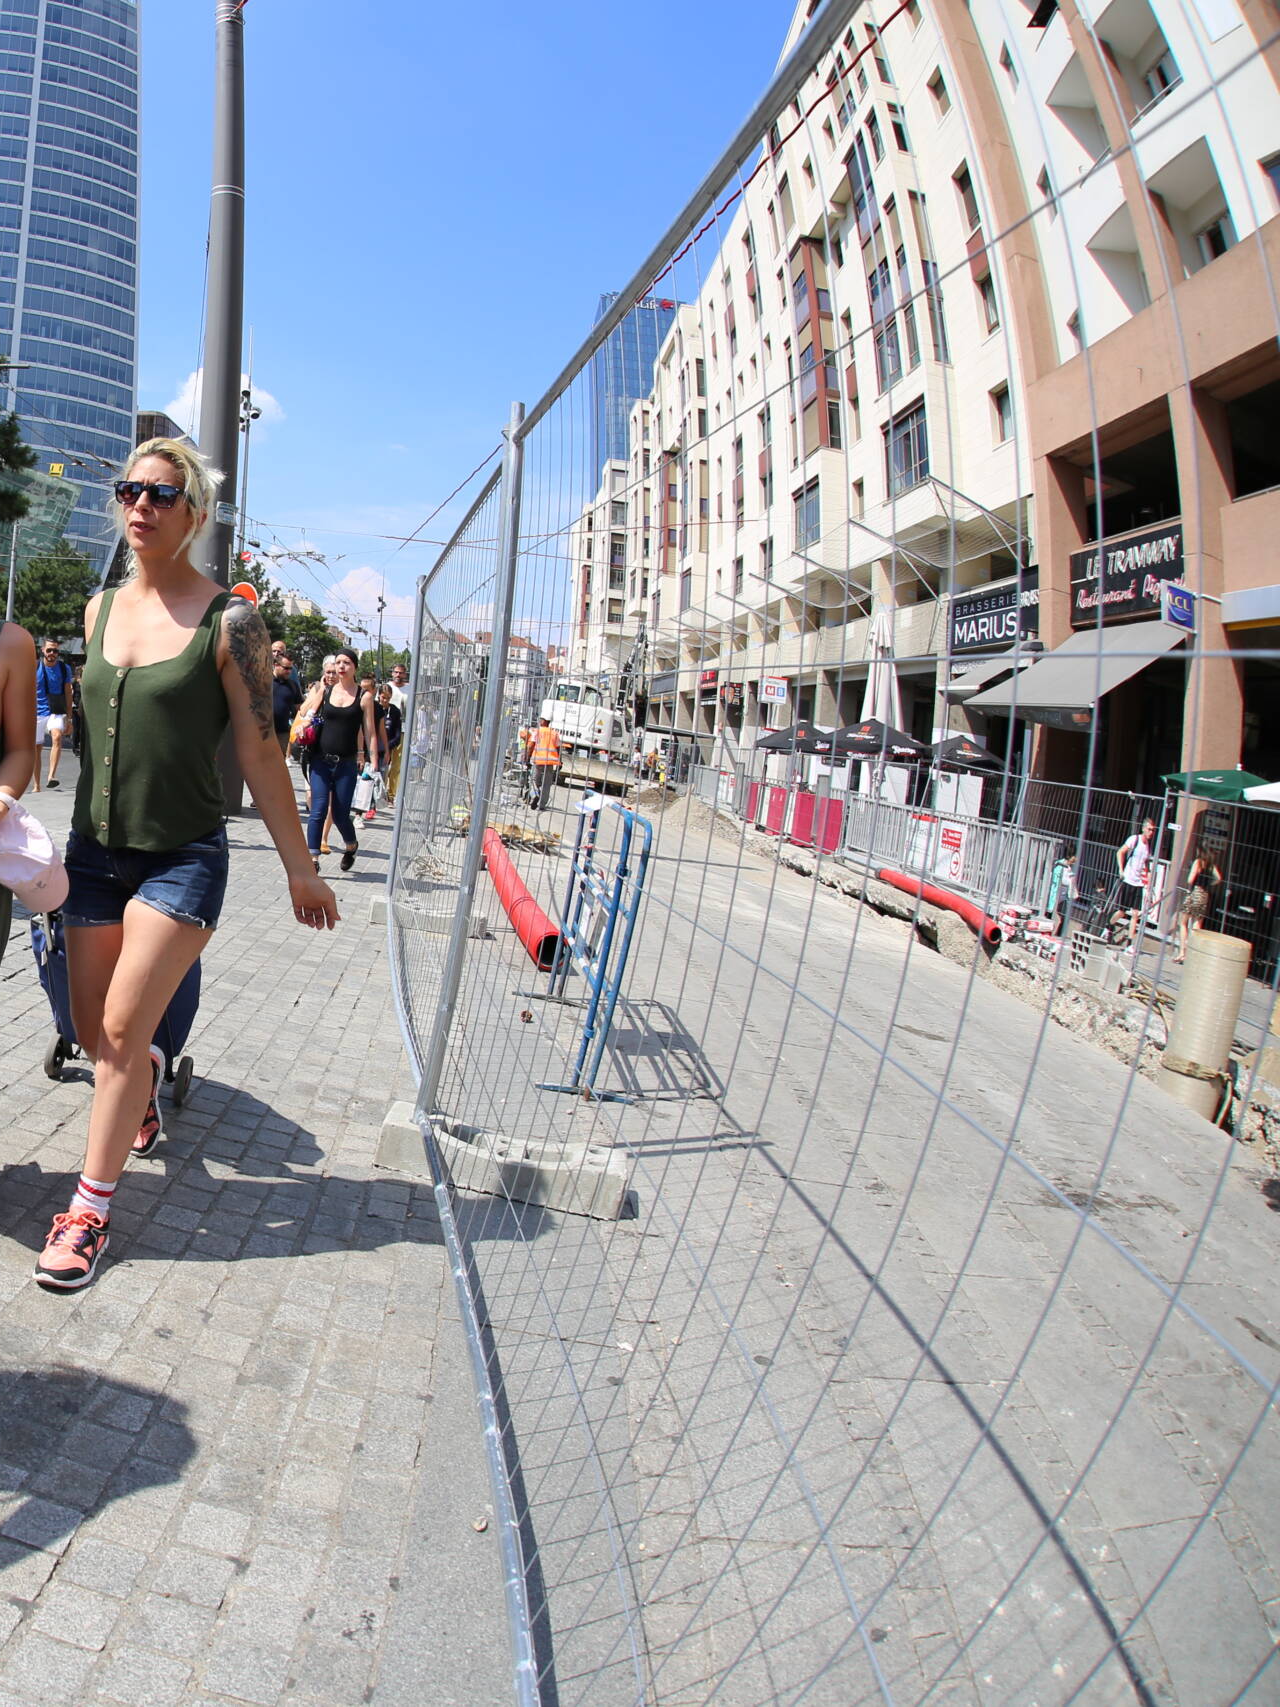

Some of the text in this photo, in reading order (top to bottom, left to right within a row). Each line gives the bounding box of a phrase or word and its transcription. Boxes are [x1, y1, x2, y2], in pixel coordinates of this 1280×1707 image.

[1086, 534, 1180, 580] LE TRAMWAY
[955, 593, 1018, 617] BRASSERIE
[1166, 591, 1190, 612] LCL
[954, 612, 1018, 645] MARIUS
